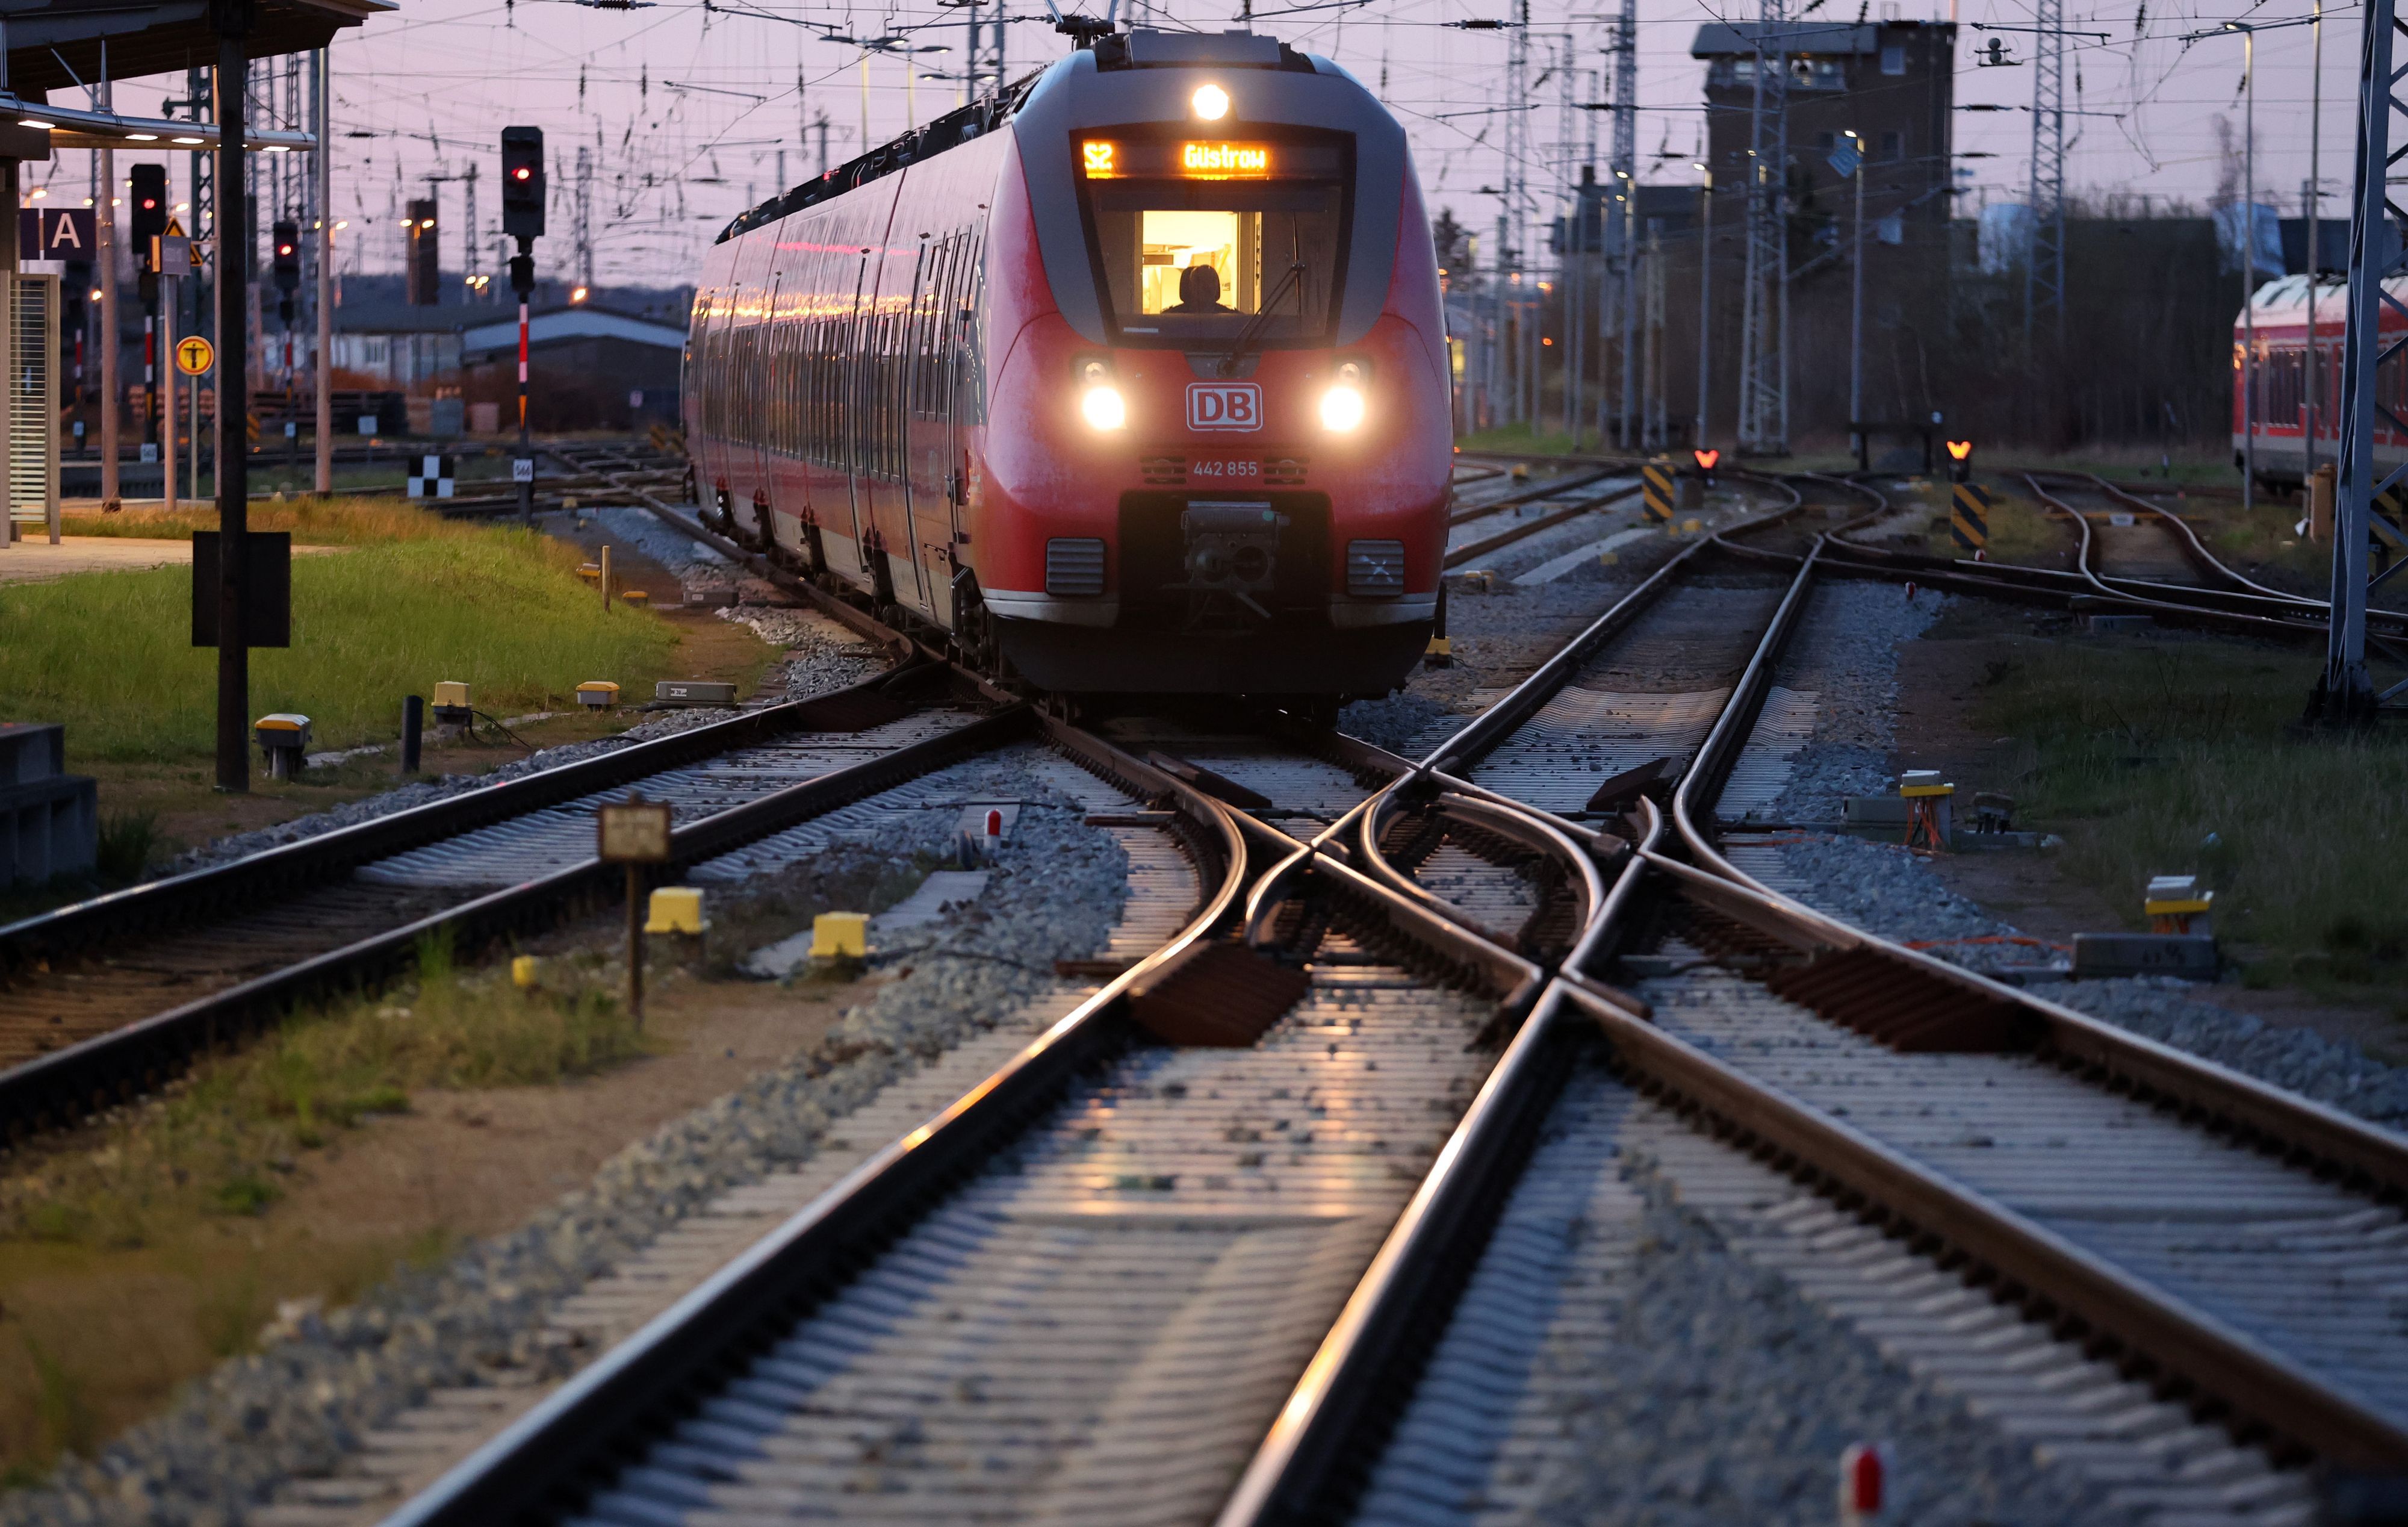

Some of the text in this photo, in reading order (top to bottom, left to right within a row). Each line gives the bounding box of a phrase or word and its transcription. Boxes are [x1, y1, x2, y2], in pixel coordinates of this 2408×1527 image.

[1084, 143, 1112, 169] S2
[51, 213, 81, 249] A
[1197, 391, 1252, 421] DB
[1194, 461, 1258, 476] 442 855
